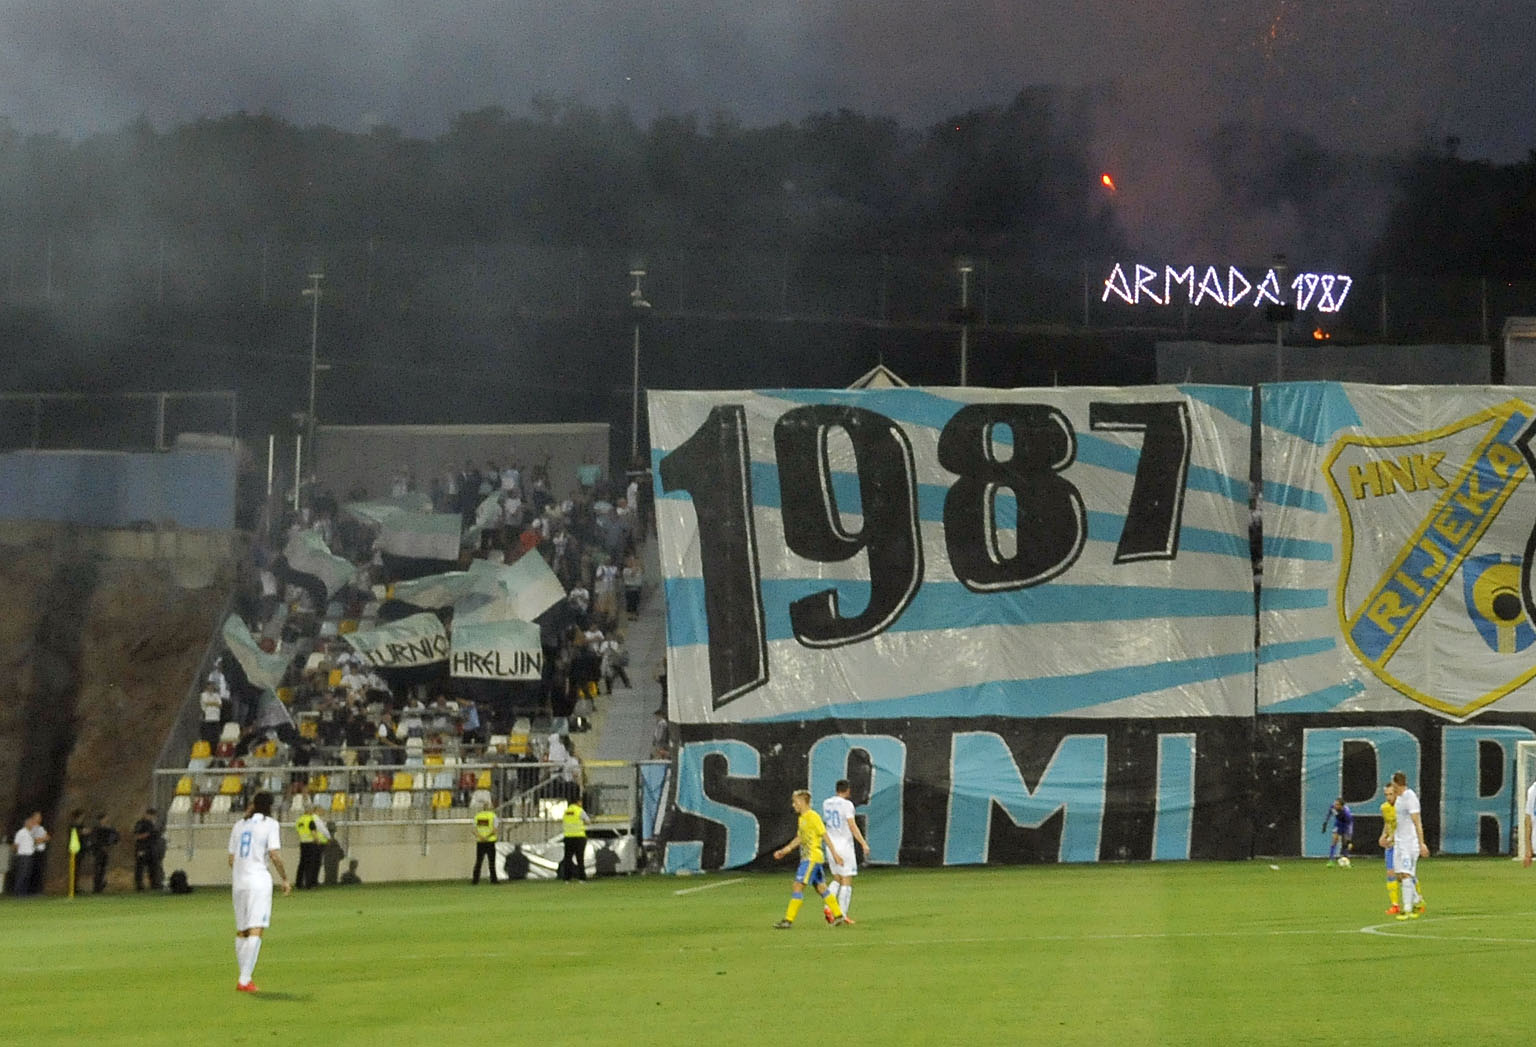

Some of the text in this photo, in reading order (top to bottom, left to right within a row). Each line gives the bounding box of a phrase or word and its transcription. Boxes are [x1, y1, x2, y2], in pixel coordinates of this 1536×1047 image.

[1101, 262, 1353, 313] ARMADA 1987
[1347, 451, 1450, 500] HNK
[659, 402, 1194, 712] 1987
[1366, 442, 1525, 636] RIJEKA
[453, 650, 542, 677] HRELJIN
[664, 731, 1197, 873] SAMI
[824, 810, 841, 829] 20
[240, 830, 252, 858] 8
